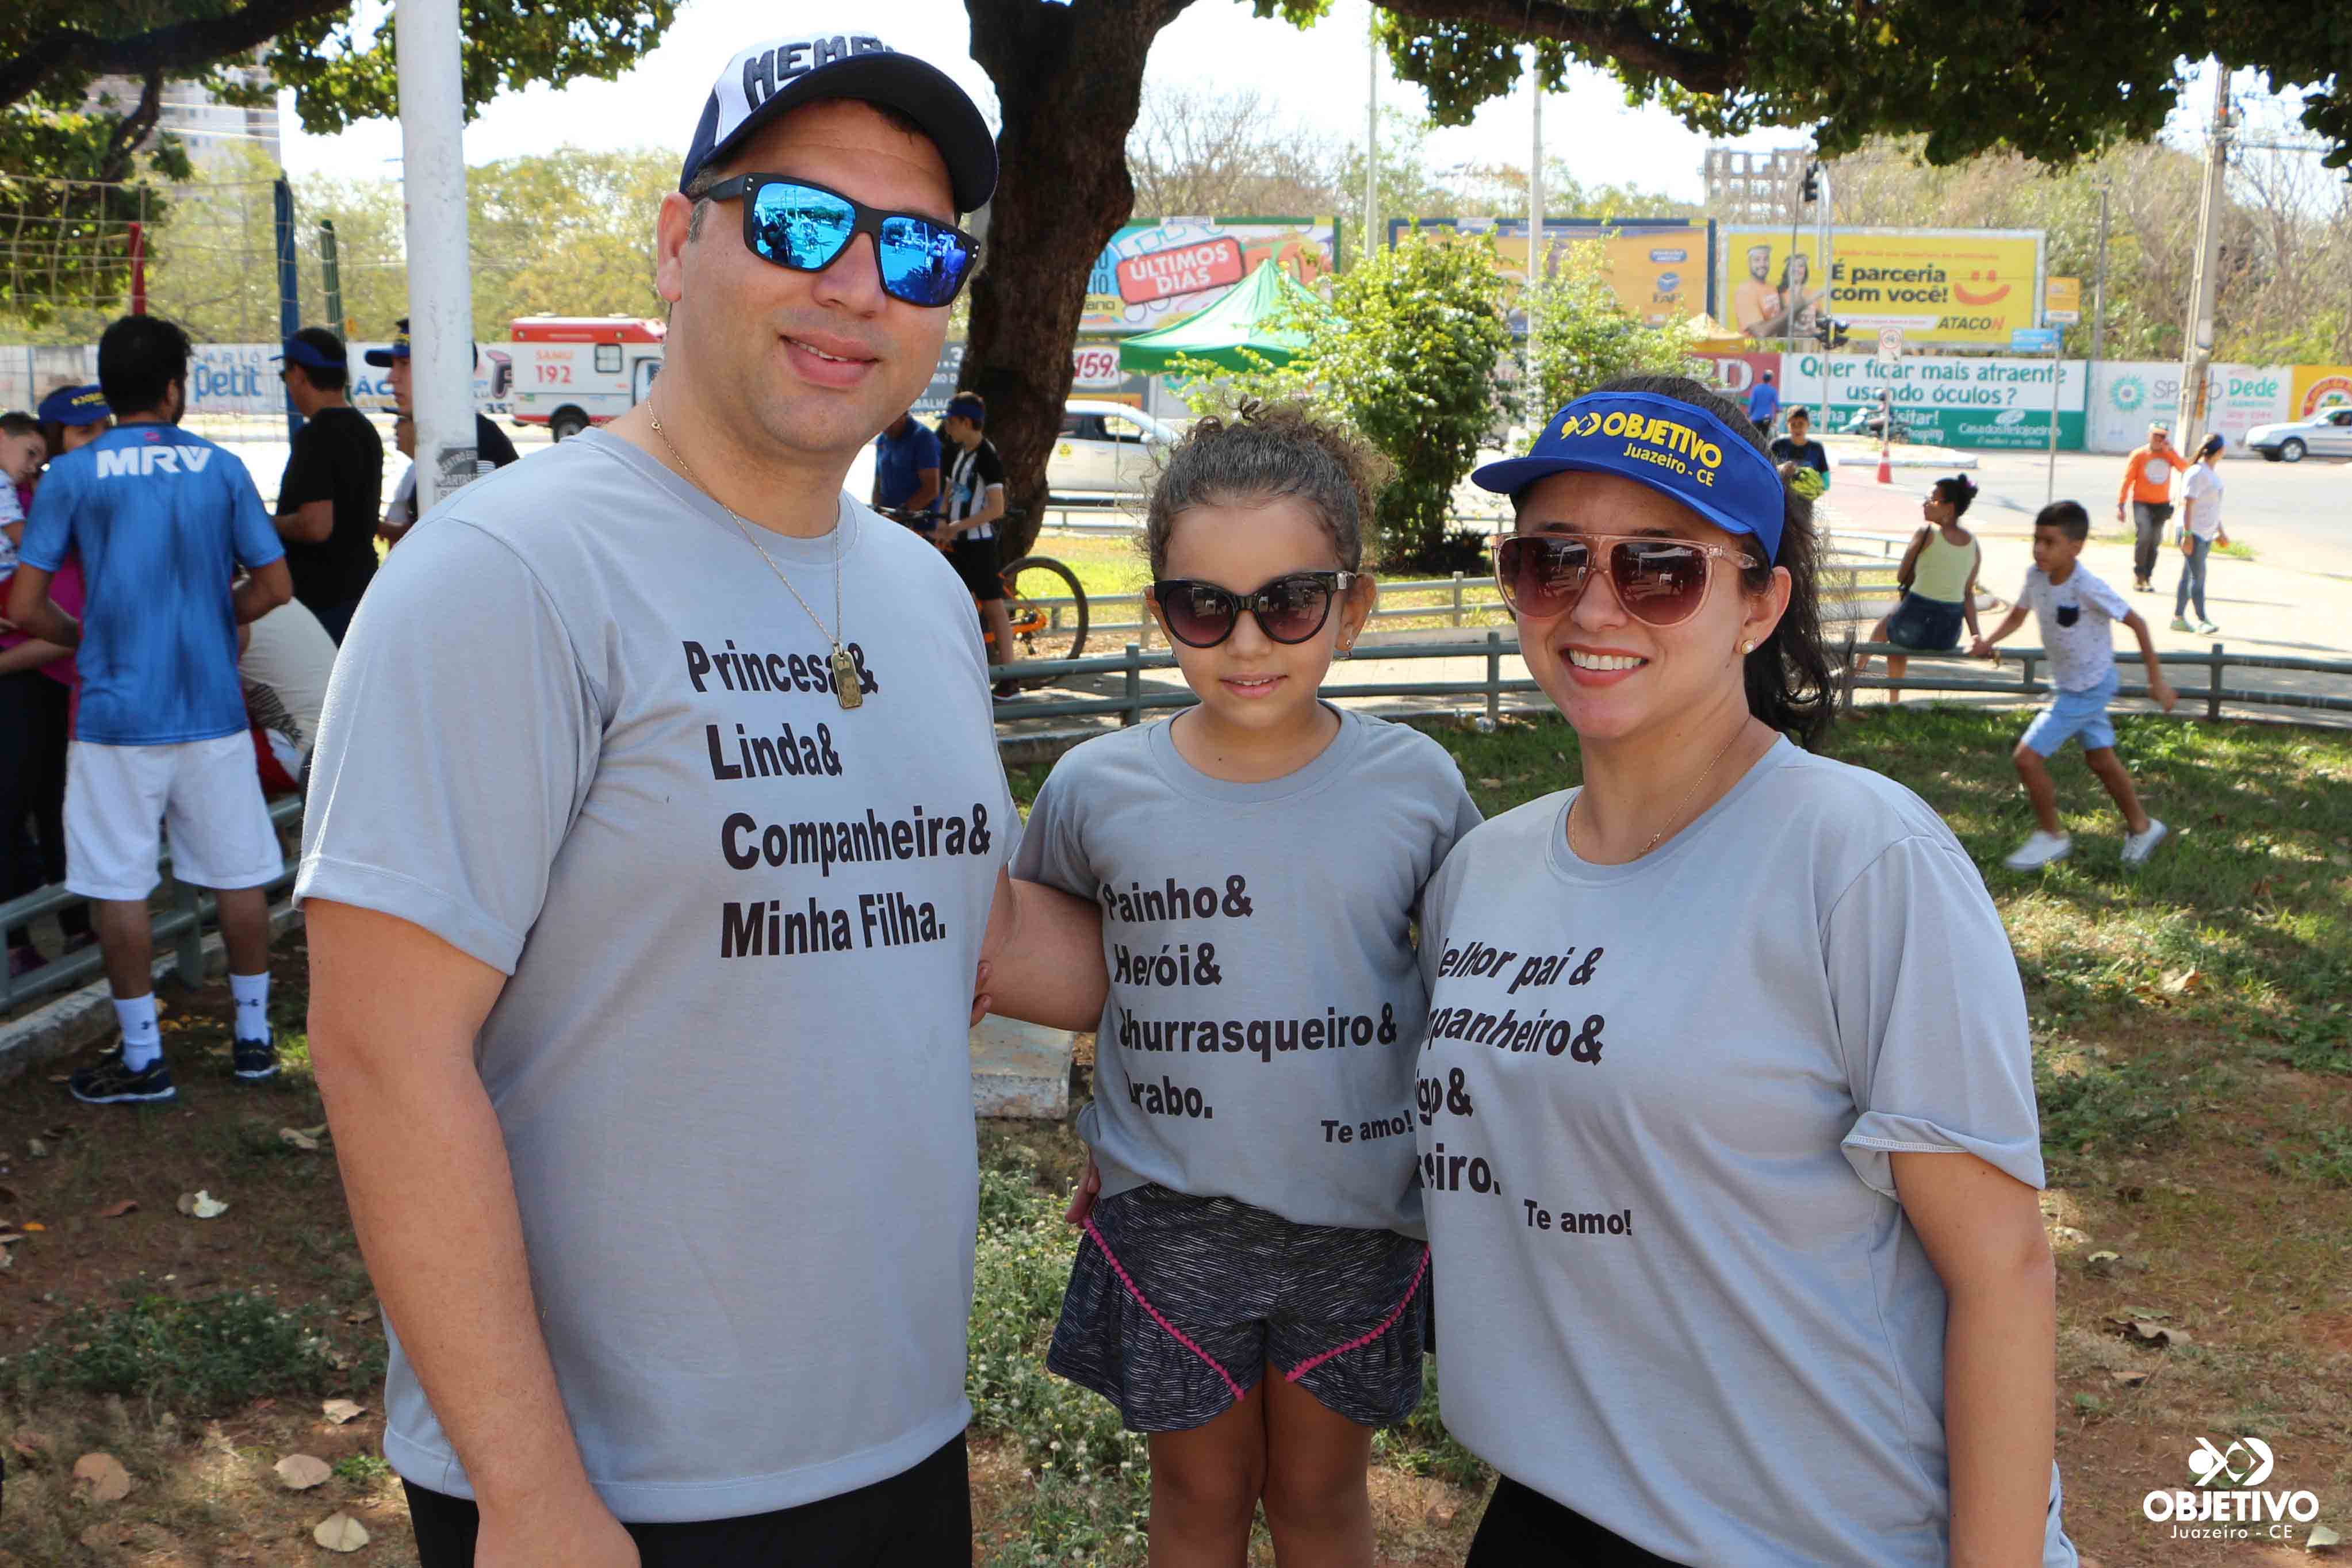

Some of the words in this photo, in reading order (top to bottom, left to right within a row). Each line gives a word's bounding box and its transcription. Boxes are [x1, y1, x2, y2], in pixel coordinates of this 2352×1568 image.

[743, 36, 894, 112] MEMP
[1129, 243, 1229, 281] ÚLTIMOS
[1155, 267, 1211, 295] DIAS
[1831, 259, 1845, 280] É
[1852, 263, 1946, 285] parceria
[1830, 287, 1880, 301] com
[1888, 285, 1948, 303] você!
[535, 365, 572, 384] 192
[1800, 356, 1857, 379] Quer
[1865, 358, 1916, 380] ficar
[1921, 361, 1970, 381] mais
[1976, 363, 2067, 385] atraente
[1847, 383, 1924, 402] usando
[1932, 383, 2001, 404] óculos
[1603, 412, 1723, 469] OBJETIVO
[97, 445, 212, 479] MRV
[1623, 442, 1686, 474] Juazeiro
[1696, 468, 1715, 487] CE
[682, 639, 879, 695] Princes&
[706, 723, 842, 780] Linda&
[721, 803, 991, 877] Companheira&
[721, 897, 853, 958] Minha
[859, 892, 946, 948] Filha.
[1114, 942, 1222, 987] Herói&
[1438, 938, 1518, 977] elhor
[1124, 1069, 1213, 1119] rabo.
[1321, 1120, 1353, 1143] Te
[1359, 1109, 1415, 1141] amo!
[1524, 1198, 1551, 1230] Te
[1561, 1209, 1633, 1236] amo!
